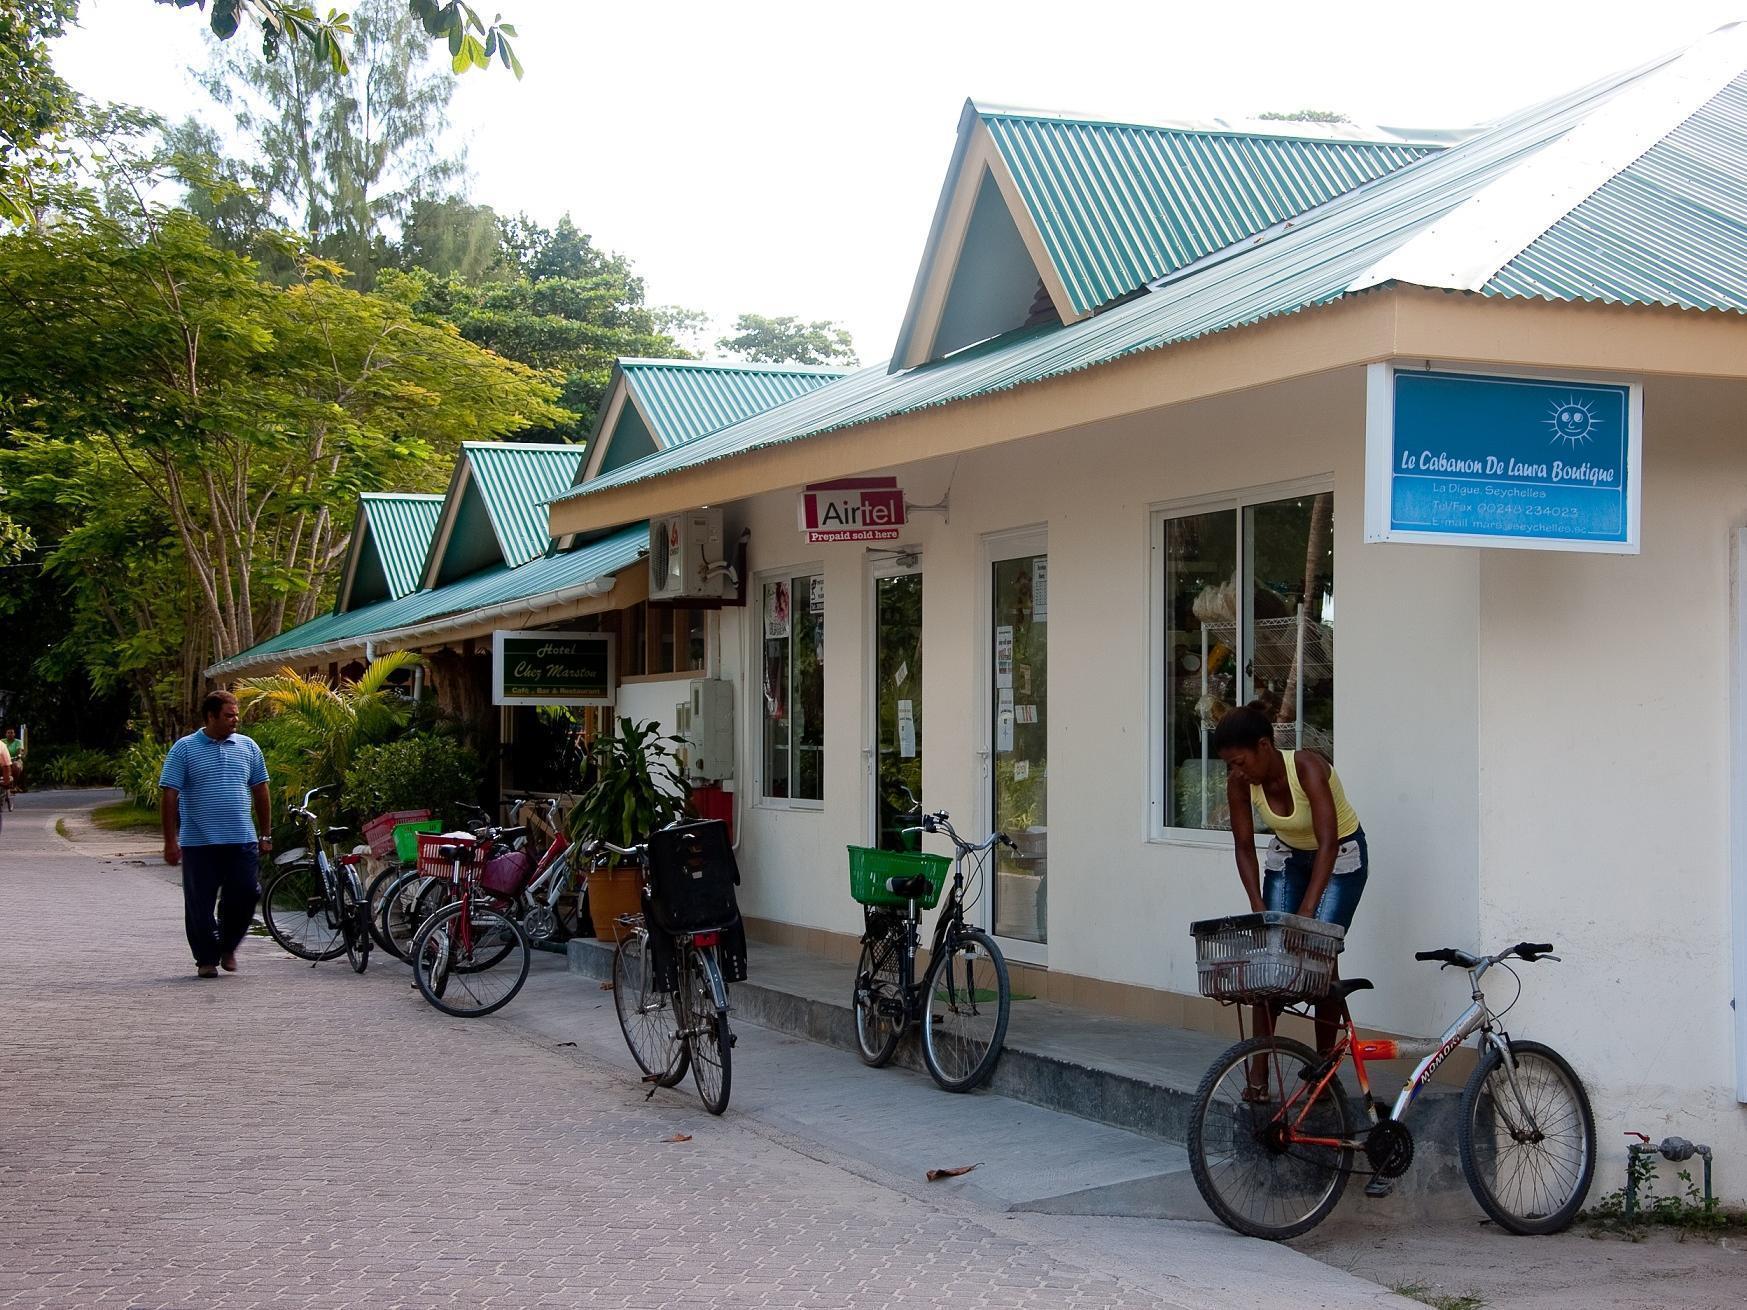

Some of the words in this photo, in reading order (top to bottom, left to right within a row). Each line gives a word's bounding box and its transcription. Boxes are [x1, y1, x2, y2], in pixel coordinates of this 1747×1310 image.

[1401, 450, 1416, 469] Le
[1419, 450, 1482, 474] Cabanon
[1485, 455, 1505, 475] De
[1507, 458, 1547, 478] Laura
[1551, 461, 1614, 486] Boutique
[1433, 483, 1446, 493] La
[1484, 486, 1546, 499] Seychelles
[822, 500, 896, 526] Airtel
[811, 531, 850, 542] Prepaid
[852, 530, 874, 540] sold
[875, 529, 898, 540] here
[536, 643, 577, 658] Hotel
[514, 660, 542, 681] Chez
